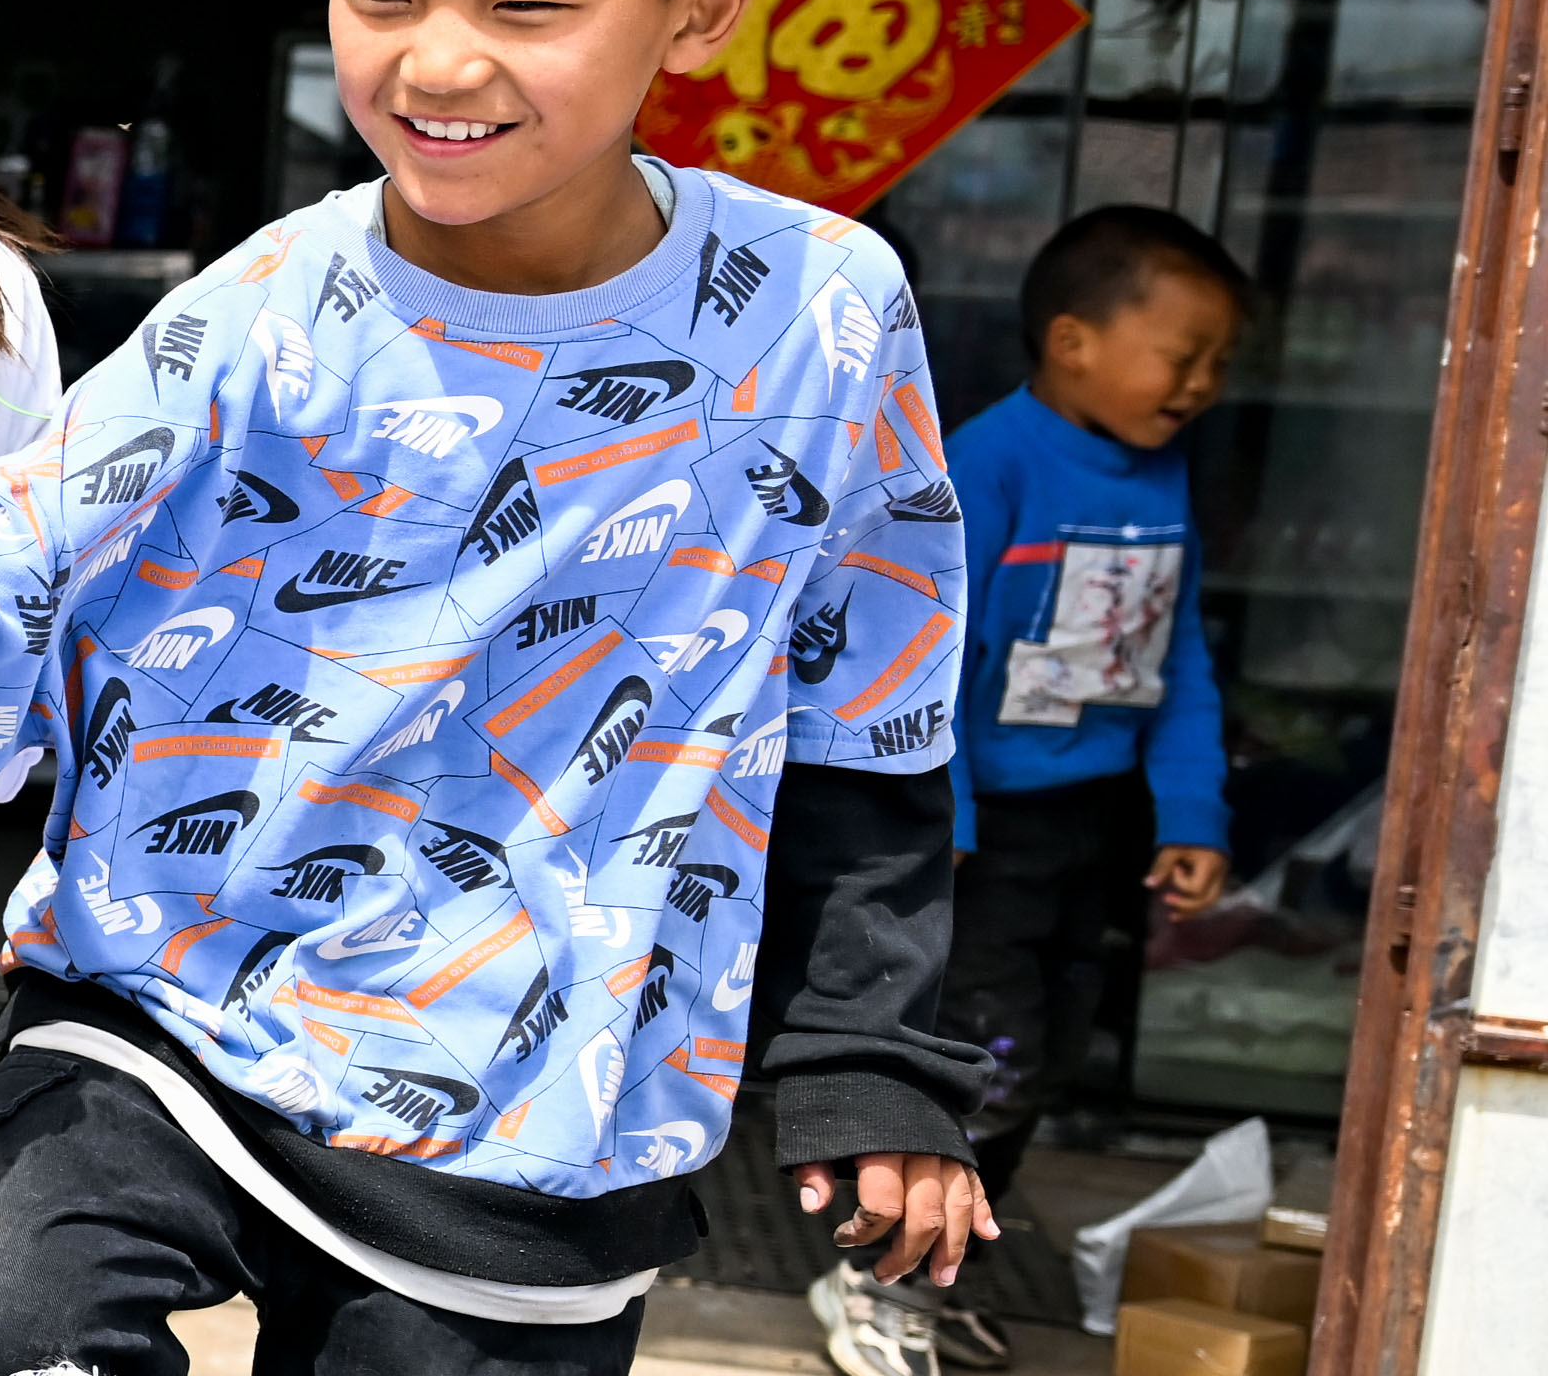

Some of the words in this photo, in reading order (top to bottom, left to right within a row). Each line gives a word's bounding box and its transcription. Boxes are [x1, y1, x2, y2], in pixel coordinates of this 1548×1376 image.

[334, 268, 380, 323] IKE
[713, 246, 770, 328] NIKE
[157, 313, 208, 382] NIKE
[276, 326, 315, 401] NIKE
[834, 293, 880, 382] NIKE
[556, 377, 661, 424] NIKE
[371, 408, 470, 459] NIKE
[80, 462, 156, 504] NIKE
[476, 488, 540, 566] NIKE
[581, 513, 671, 563] NIKE
[303, 549, 407, 590] NIKE
[15, 595, 52, 656] NIKE
[517, 596, 595, 650] NIKE
[238, 683, 338, 729] NIKE
[868, 700, 945, 757] NIKE
[88, 707, 138, 790] NIKE
[580, 709, 644, 786] NIKE
[145, 818, 238, 855] NIKE
[419, 831, 501, 892] NIKE
[633, 831, 689, 868] IKE
[271, 862, 343, 903] NIKE
[463, 943, 502, 969] forget
[499, 919, 530, 954] Don't
[301, 985, 322, 1000] Don't
[322, 993, 365, 1010] forget
[367, 1001, 381, 1011] to
[418, 977, 449, 1001] smile
[516, 991, 569, 1064] NIKE
[361, 1074, 446, 1130] NIKE
